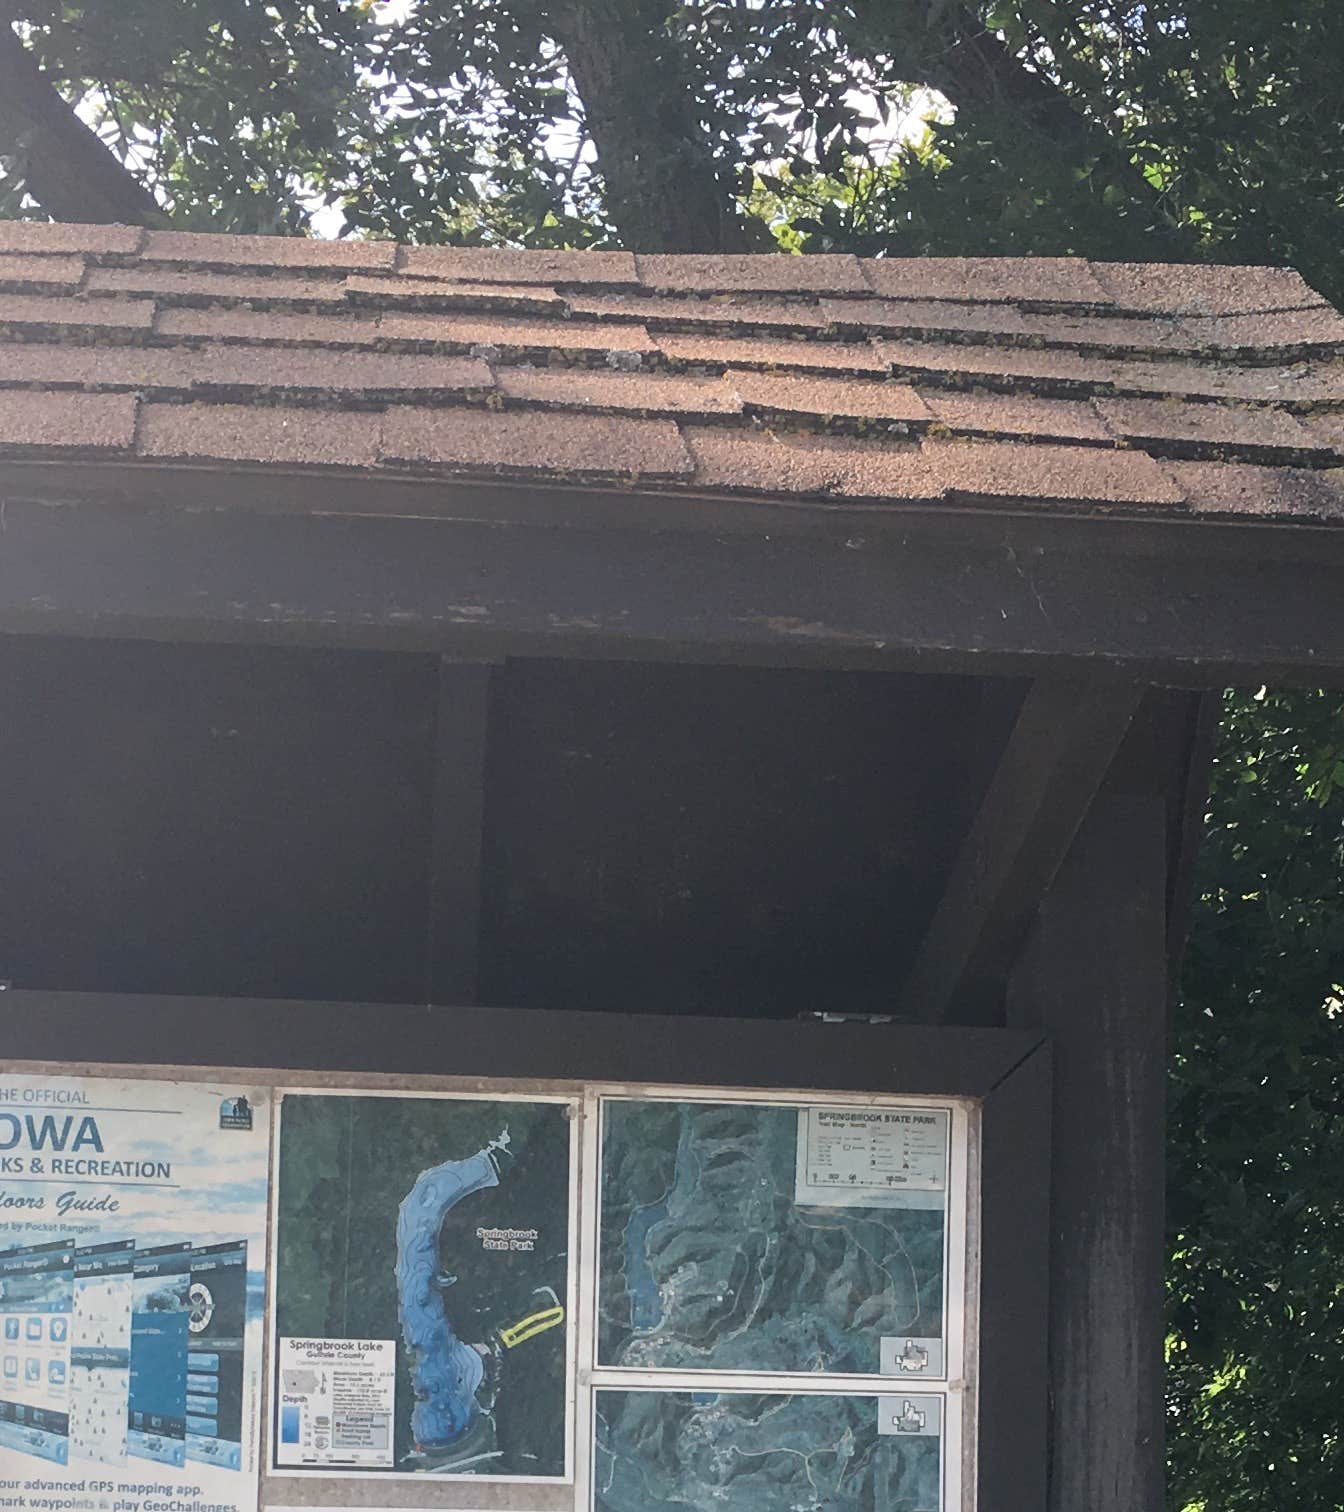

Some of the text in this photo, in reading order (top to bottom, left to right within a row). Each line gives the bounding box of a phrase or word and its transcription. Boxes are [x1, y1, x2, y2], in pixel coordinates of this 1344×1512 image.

[23, 1088, 90, 1104] OFFICIAL
[818, 1112, 936, 1124] SPRINGBROOK STATE PARK
[30, 1157, 44, 1173] &
[51, 1158, 170, 1179] RECREATION
[56, 1191, 121, 1216] Guide
[11, 1222, 22, 1233] by
[25, 1222, 57, 1232] Pocket
[477, 1227, 538, 1240] Springbrook
[483, 1240, 534, 1251] State Park
[290, 1340, 383, 1351] Springbrook Lake
[337, 1352, 365, 1360] County
[282, 1395, 307, 1403] Depth
[0, 1479, 20, 1489] our
[24, 1479, 85, 1492] advanced
[89, 1481, 114, 1493] GPS
[117, 1483, 173, 1497] mapping
[176, 1486, 204, 1497] app.
[29, 1496, 94, 1511] waypoints
[113, 1500, 139, 1512] play
